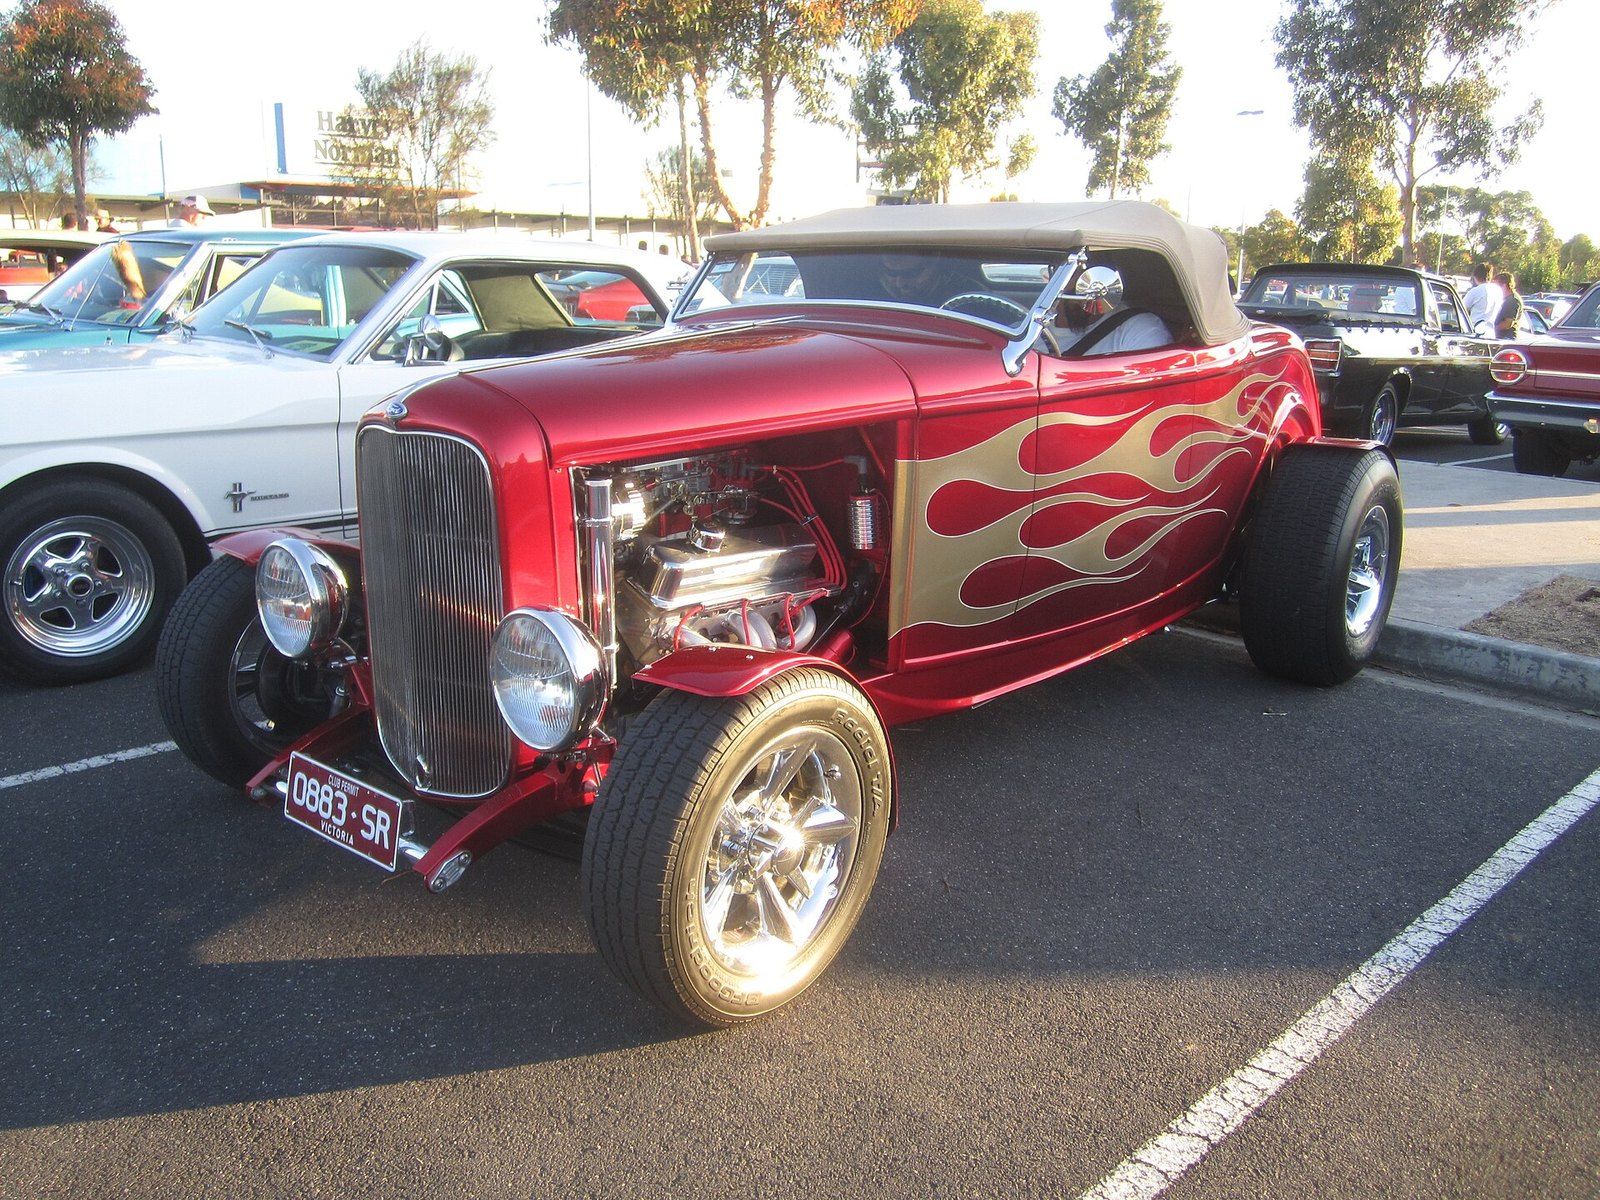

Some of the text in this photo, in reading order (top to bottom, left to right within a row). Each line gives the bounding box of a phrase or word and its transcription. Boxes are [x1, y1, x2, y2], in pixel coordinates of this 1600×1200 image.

[831, 707, 880, 769] Radial
[328, 774, 360, 797] CLUB PERMIT
[320, 820, 354, 846] VICTORIA
